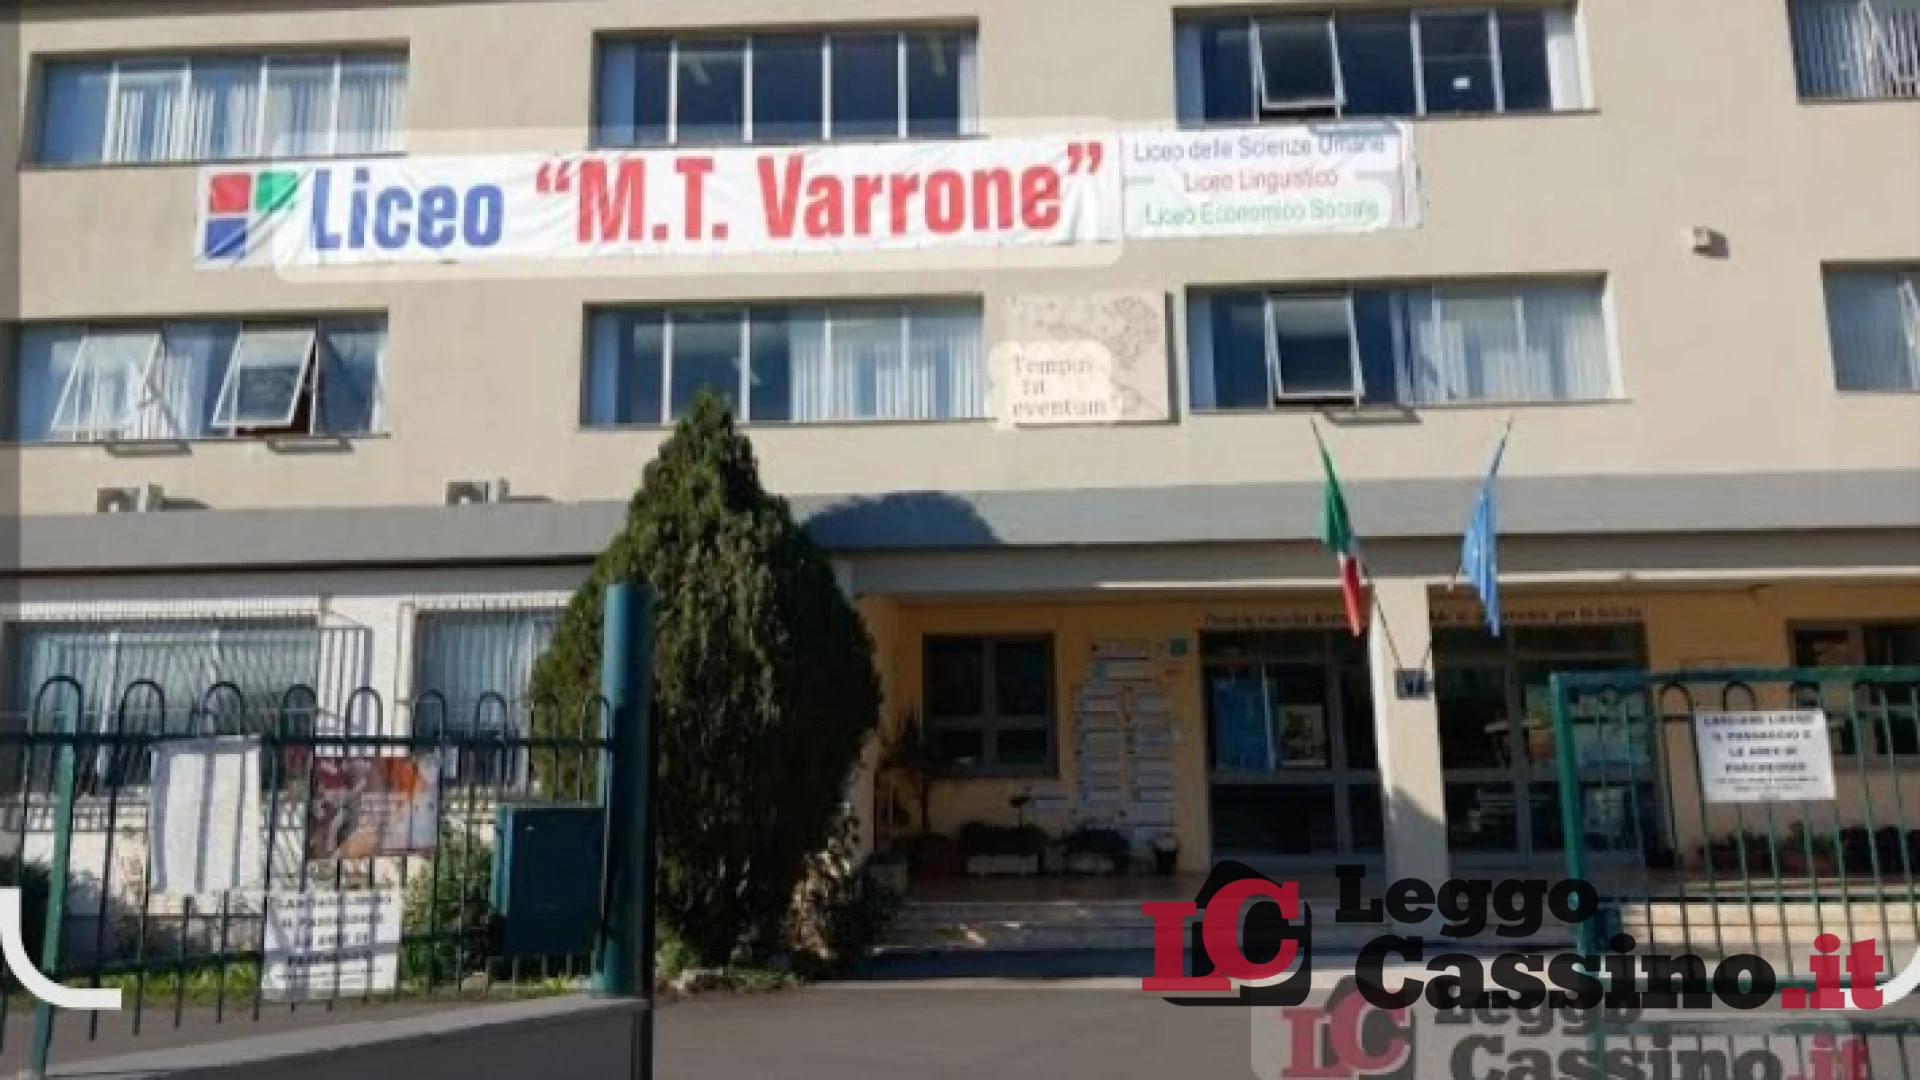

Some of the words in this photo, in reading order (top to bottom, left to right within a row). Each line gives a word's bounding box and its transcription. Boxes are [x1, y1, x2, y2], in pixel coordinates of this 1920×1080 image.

[1133, 138, 1184, 164] Liceo
[1188, 137, 1232, 160] delle
[1238, 135, 1311, 159] Scienze
[1184, 170, 1234, 192] Liceo
[1239, 167, 1338, 193] Linguistico
[310, 166, 504, 252] Liceo
[756, 141, 1105, 240] Varrone”
[1145, 203, 1196, 226] Liceo
[1201, 201, 1306, 225] Economico
